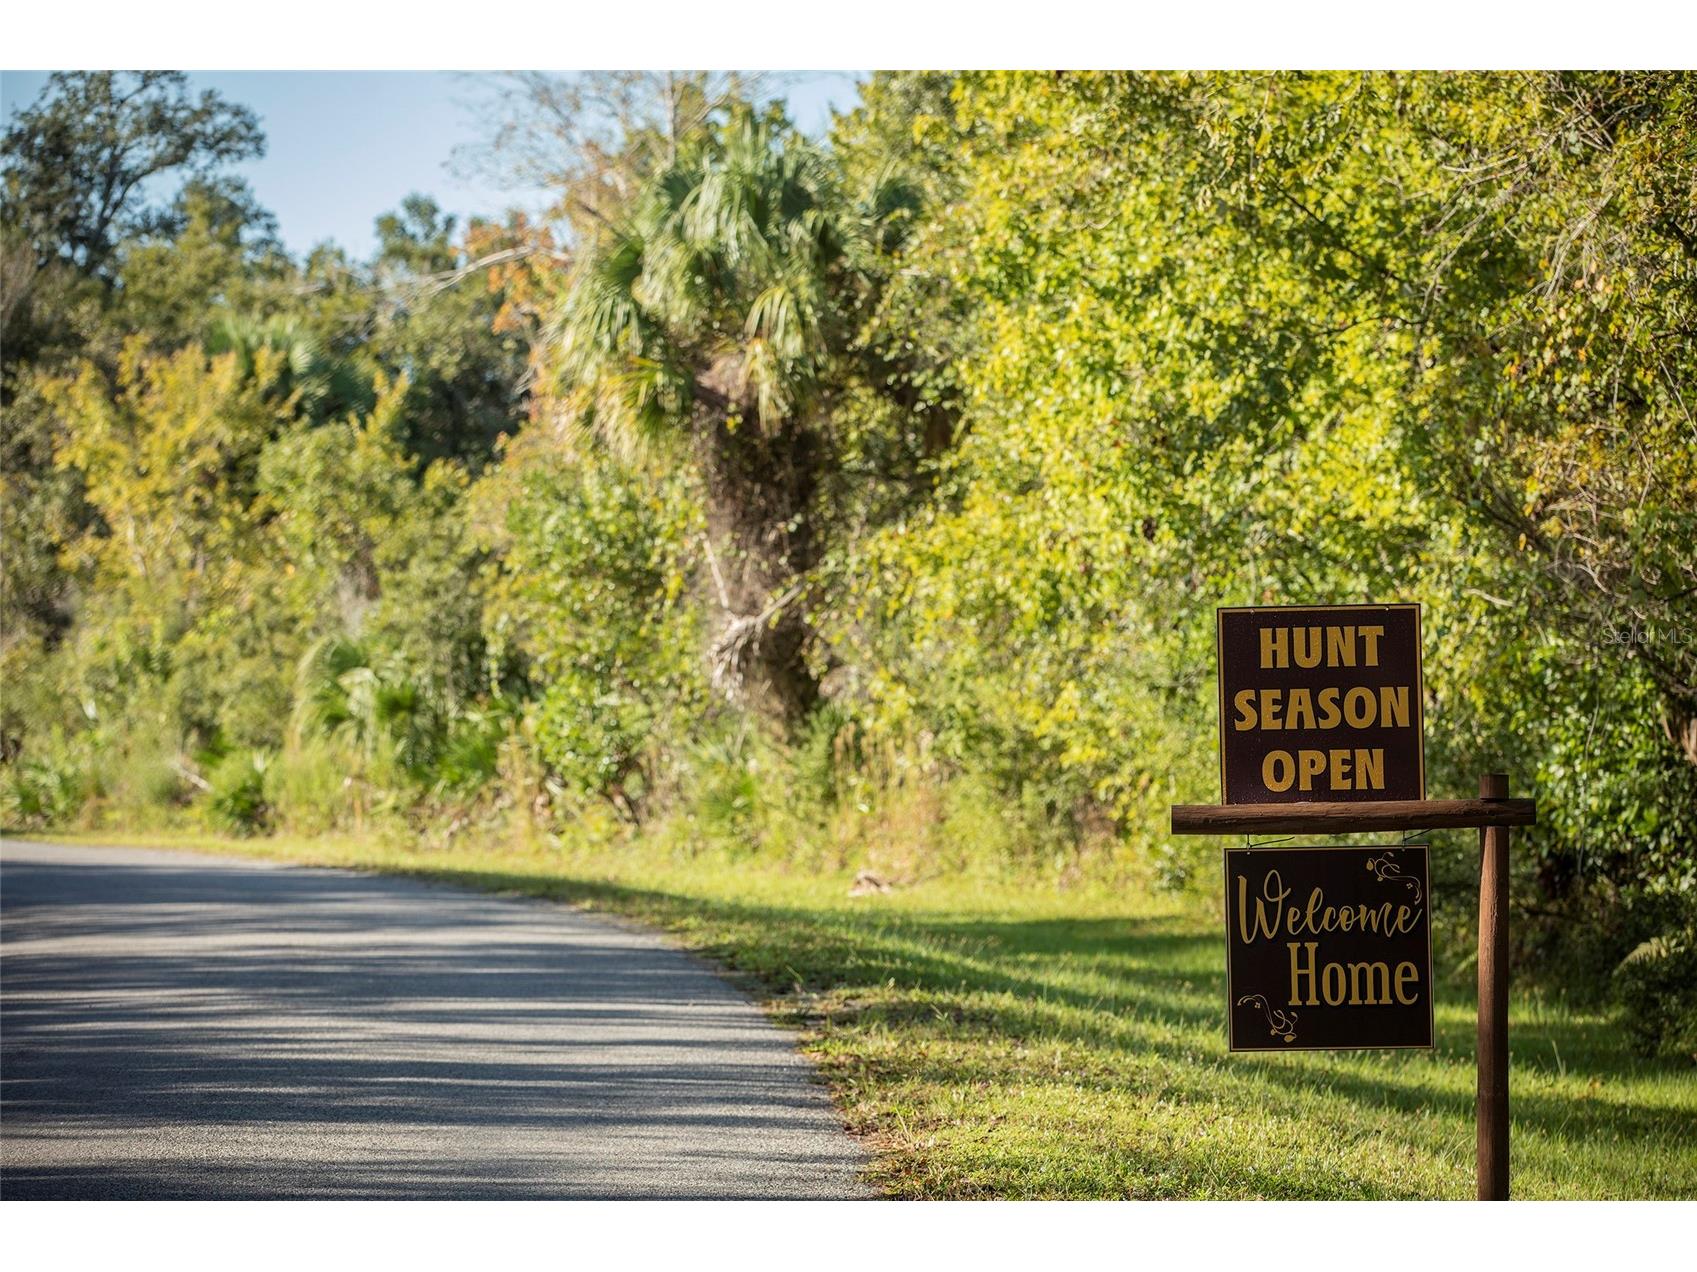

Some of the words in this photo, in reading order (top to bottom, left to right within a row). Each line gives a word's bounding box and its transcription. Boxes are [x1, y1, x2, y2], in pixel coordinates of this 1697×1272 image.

[1259, 625, 1385, 669] HUNT
[1234, 686, 1411, 731] SEASON
[1261, 748, 1386, 793] OPEN
[1237, 869, 1423, 945] Welcome
[1286, 941, 1419, 1007] Home
